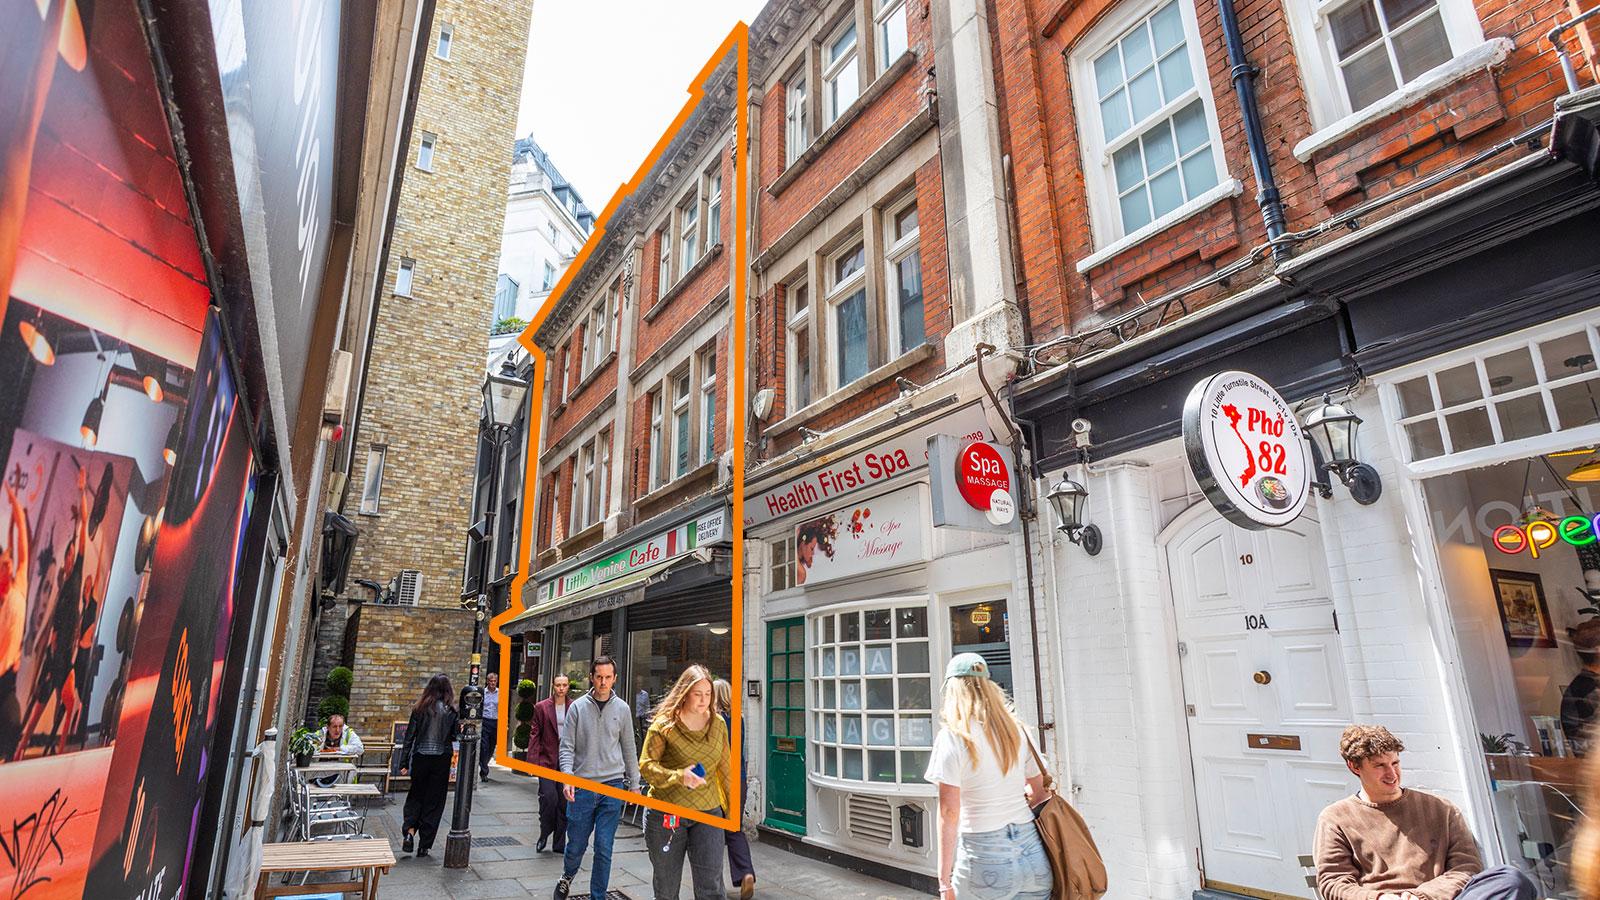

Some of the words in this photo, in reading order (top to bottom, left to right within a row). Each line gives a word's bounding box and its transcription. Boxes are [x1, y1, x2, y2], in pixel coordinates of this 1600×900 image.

[1223, 378, 1249, 392] Turnstile
[1212, 390, 1225, 409] Little
[1211, 408, 1218, 419] 10
[1247, 407, 1285, 438] Phở
[970, 451, 1000, 476] Spa
[1258, 441, 1287, 476] 82
[765, 480, 818, 517] Health
[817, 460, 865, 498] First
[864, 448, 910, 479] Spa
[967, 475, 1008, 489] MASSAGE
[992, 498, 1012, 507] NATURAL
[697, 521, 707, 531] FREE
[707, 515, 722, 529] OFFICE
[880, 517, 901, 536] Spa
[698, 527, 719, 541] DELIVERY
[1493, 512, 1600, 559] ope
[857, 536, 903, 560] Massage
[565, 572, 588, 593] Little
[590, 559, 626, 582] Venice
[629, 543, 660, 567] Cafe
[1239, 554, 1253, 565] 10
[1244, 614, 1270, 630] 10A
[825, 650, 888, 674] SPA
[845, 685, 858, 705] &
